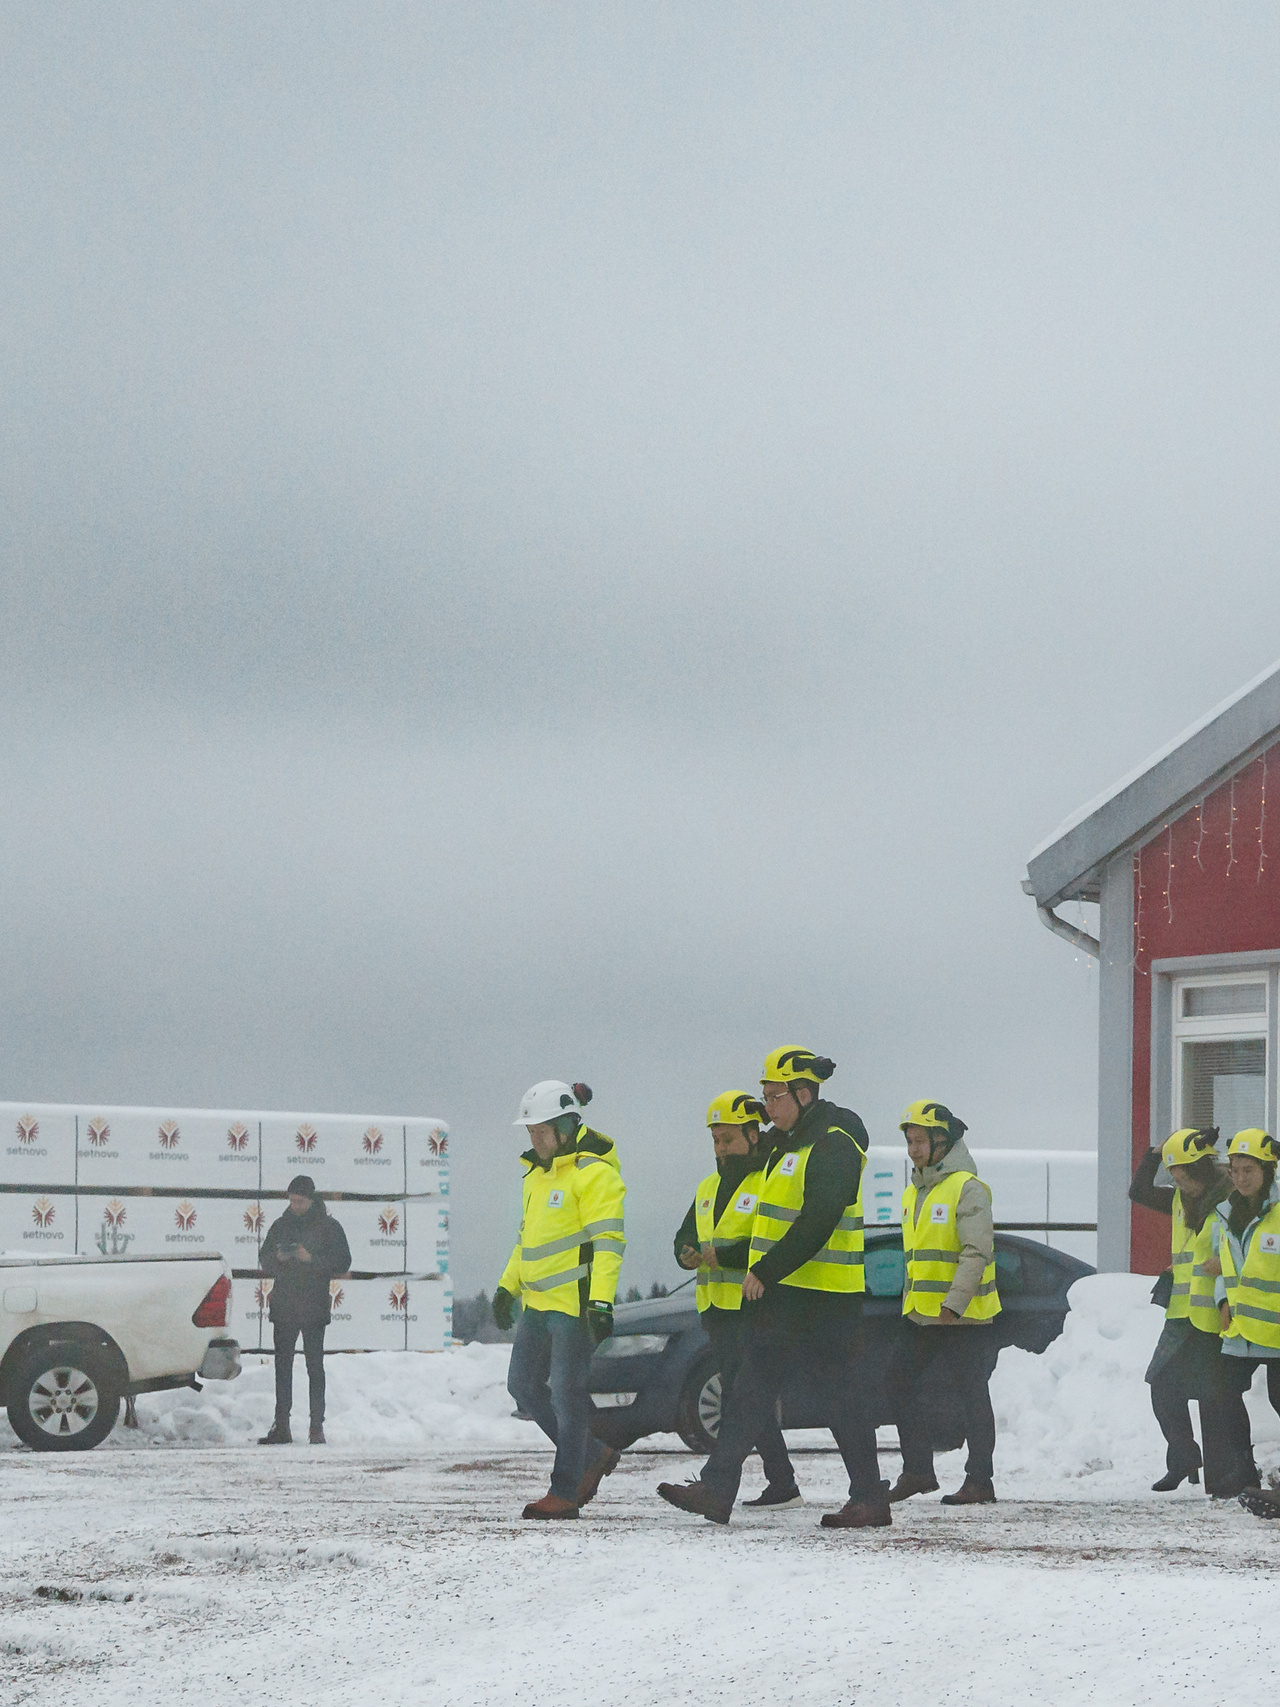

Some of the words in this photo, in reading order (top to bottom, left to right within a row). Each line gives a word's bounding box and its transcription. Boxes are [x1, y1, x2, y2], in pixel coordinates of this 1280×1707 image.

[6, 1146, 48, 1156] setnovo
[149, 1151, 189, 1161] setnovo
[219, 1153, 258, 1162] setnovo
[287, 1155, 326, 1165] setnovo
[354, 1157, 392, 1166] setnovo
[419, 1158, 449, 1167] setno
[23, 1230, 64, 1240] setnovo
[165, 1233, 205, 1243] setnovo
[234, 1235, 265, 1244] setno
[330, 1313, 352, 1321] novo
